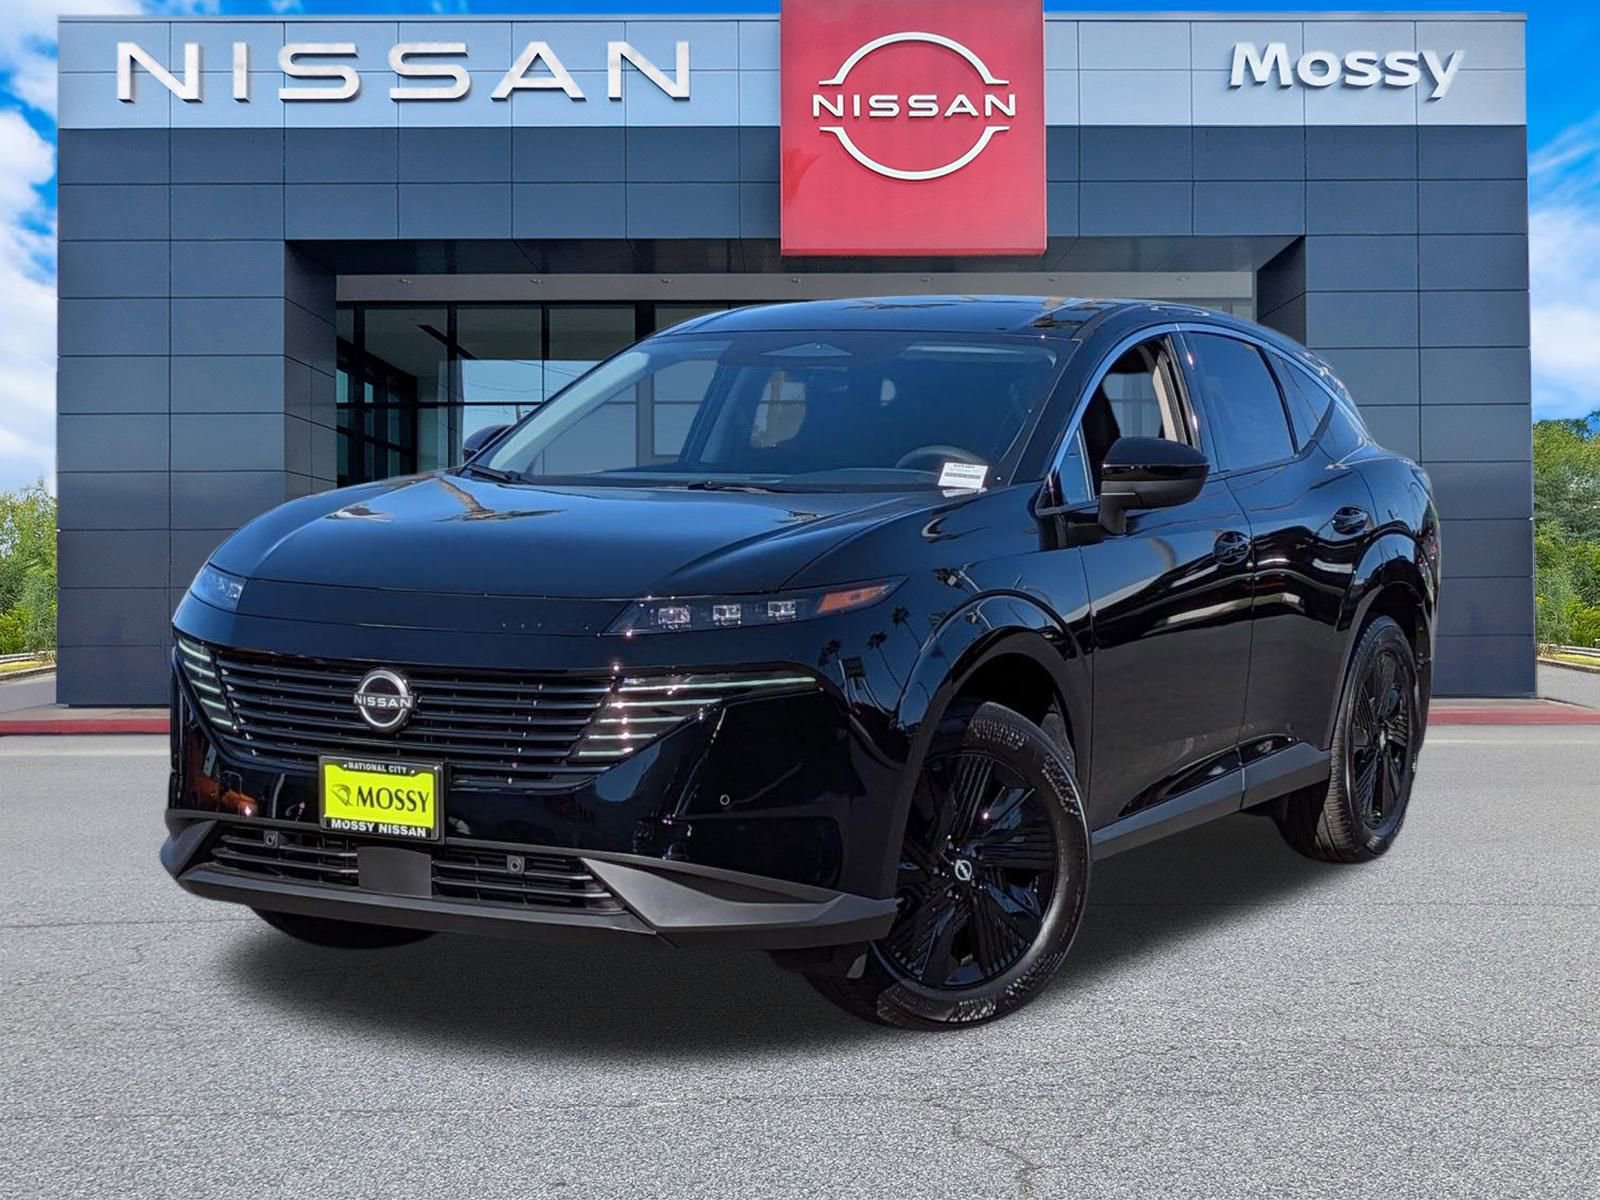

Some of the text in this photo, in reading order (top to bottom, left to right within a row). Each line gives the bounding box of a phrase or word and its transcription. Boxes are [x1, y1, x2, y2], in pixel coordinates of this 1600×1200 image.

[117, 41, 691, 103] NISSAN
[1229, 41, 1466, 101] Mossy
[812, 93, 1017, 118] NISSAN
[353, 693, 412, 707] NISSAN
[348, 762, 407, 774] NATIONAL CITY
[356, 785, 429, 812] MOSSY
[331, 819, 426, 837] MOSSY NISSAN
